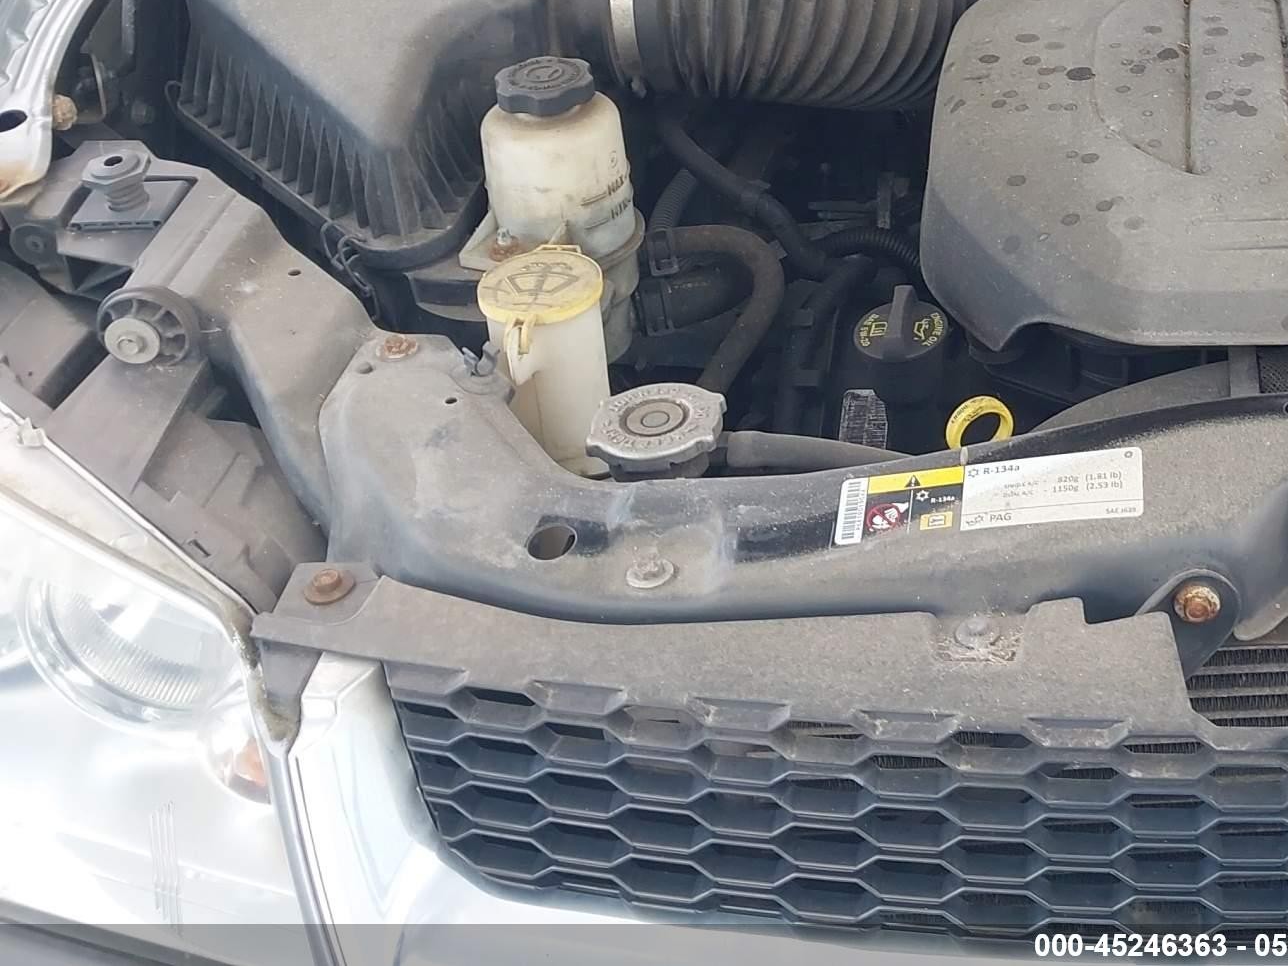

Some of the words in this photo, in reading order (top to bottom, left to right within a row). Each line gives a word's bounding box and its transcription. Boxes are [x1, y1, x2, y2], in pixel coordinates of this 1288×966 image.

[931, 312, 944, 336] ENGINE
[921, 335, 938, 347] OIL
[983, 465, 1020, 475] R-134a
[1057, 474, 1079, 483] 820g
[1085, 472, 1107, 483] (1.81
[1109, 470, 1122, 481] lb)
[1052, 484, 1079, 493] 1150g
[1086, 481, 1109, 492] (2.53
[1110, 479, 1123, 490] lb)
[989, 512, 1013, 523] PAG
